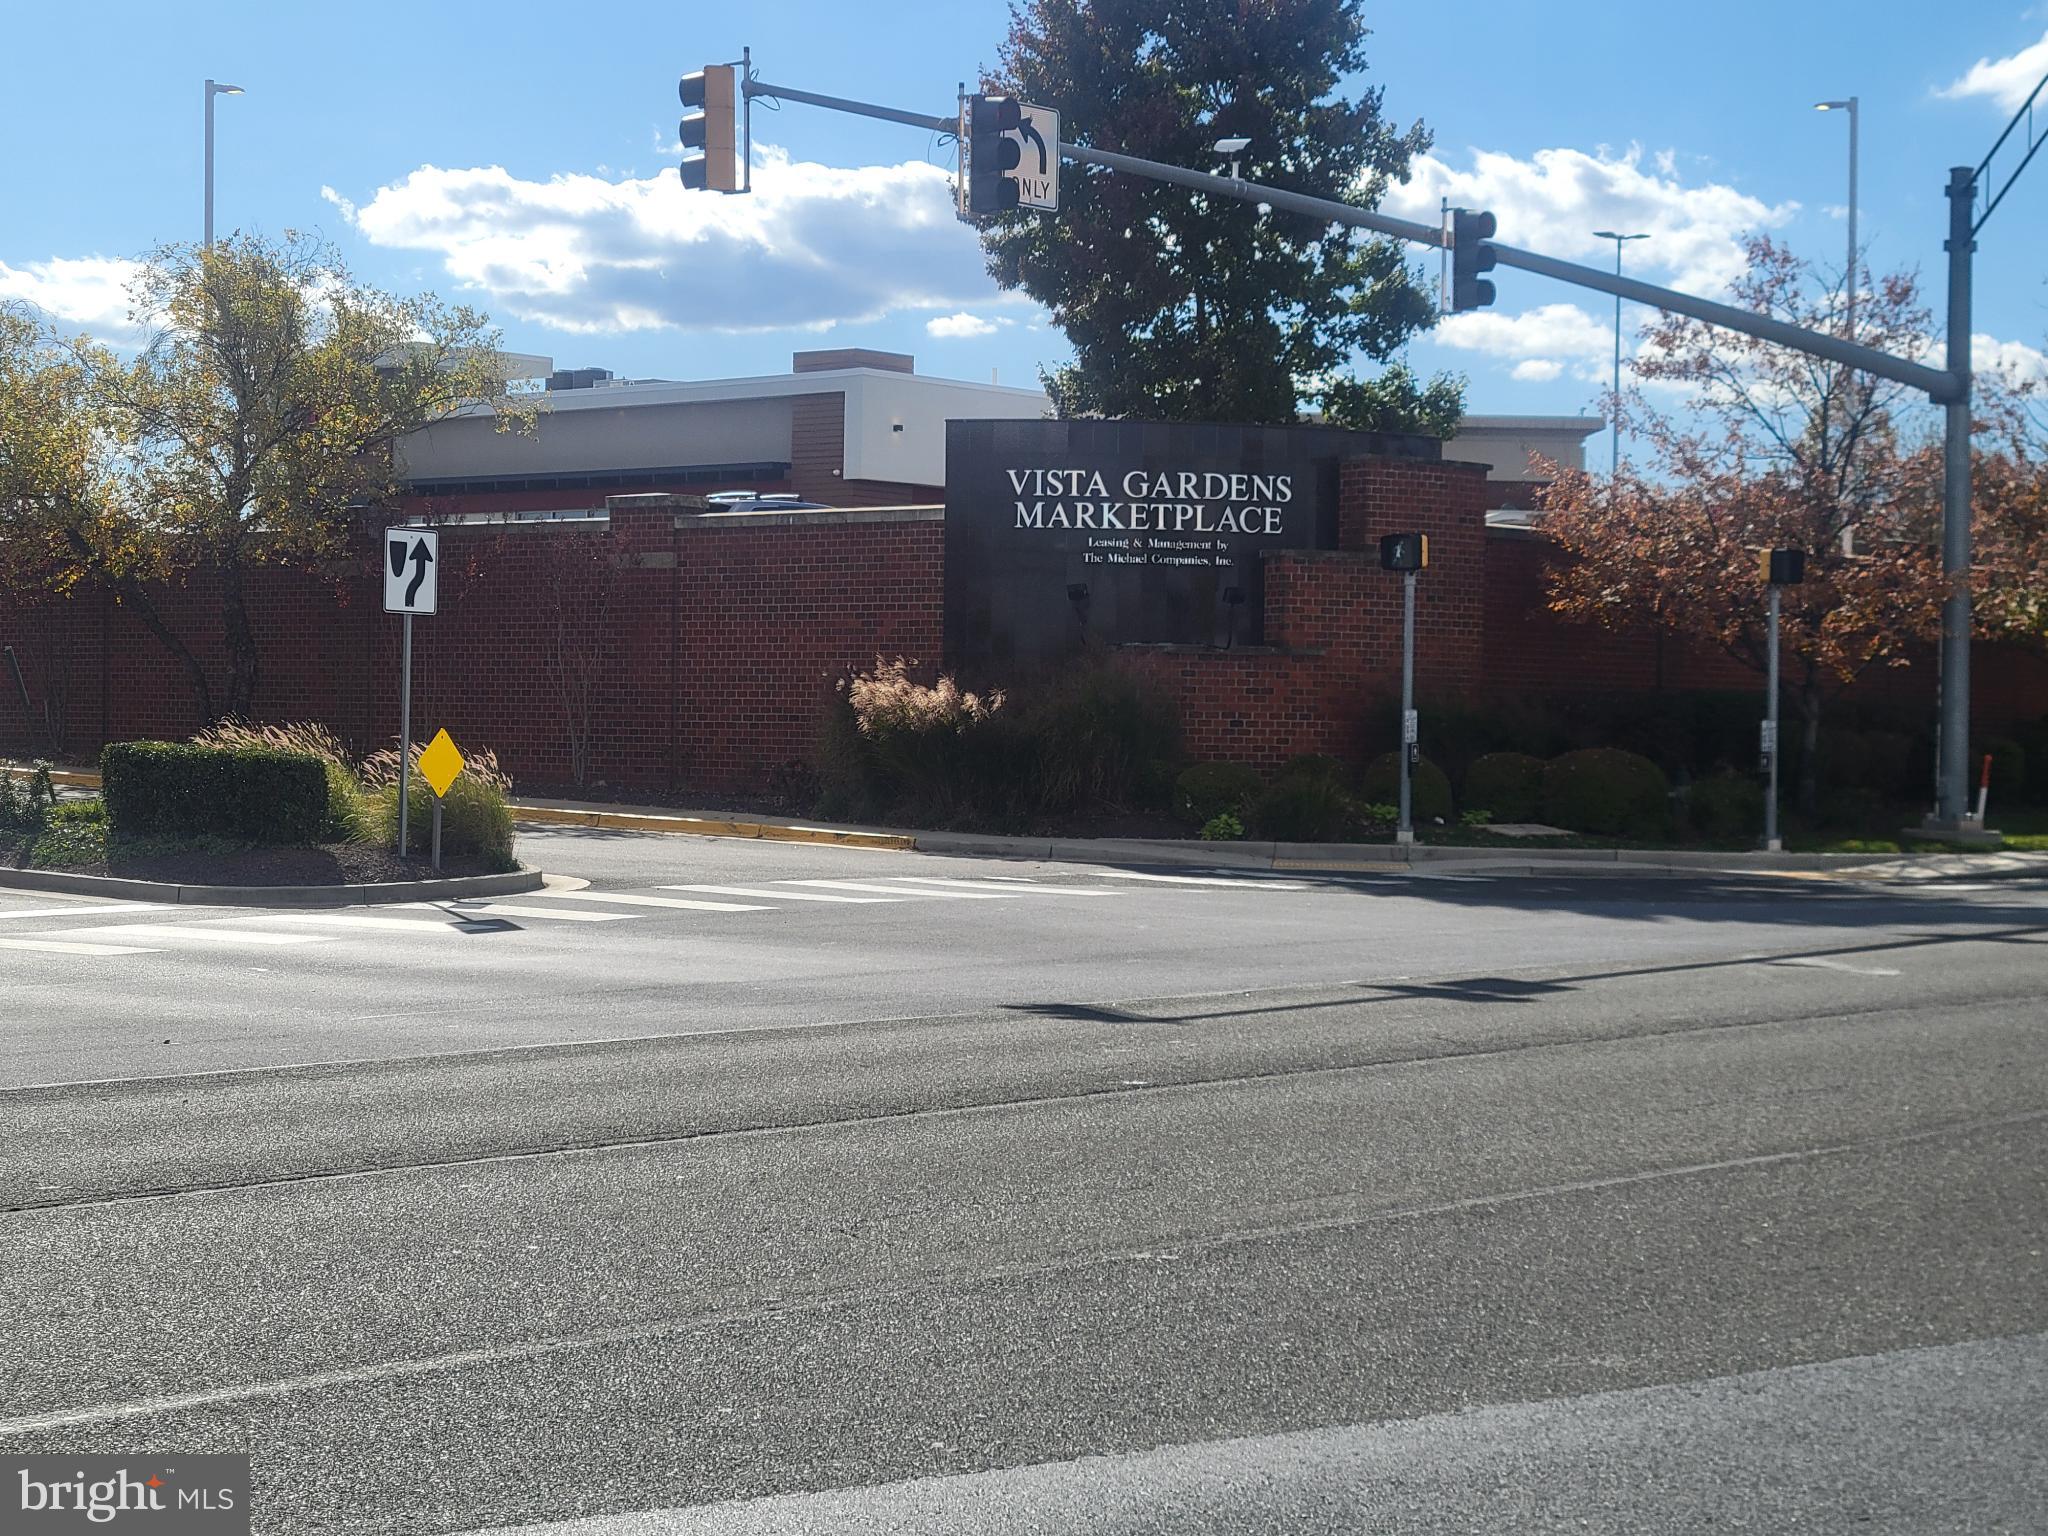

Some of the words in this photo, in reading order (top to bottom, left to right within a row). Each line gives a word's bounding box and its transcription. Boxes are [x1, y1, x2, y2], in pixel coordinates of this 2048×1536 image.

[1013, 176, 1050, 200] NLY
[1006, 469, 1110, 497] VISTA
[1122, 471, 1293, 503] GARDENS
[1014, 501, 1283, 534] MARKETPLACE
[1088, 536, 1129, 549] Leasing
[1133, 538, 1143, 548] &
[1148, 537, 1212, 551] Management
[1216, 539, 1229, 552] by
[1083, 552, 1103, 563] The
[1107, 553, 1148, 564] Michael
[1151, 554, 1212, 567] Companies,
[1215, 556, 1234, 566] Inc.
